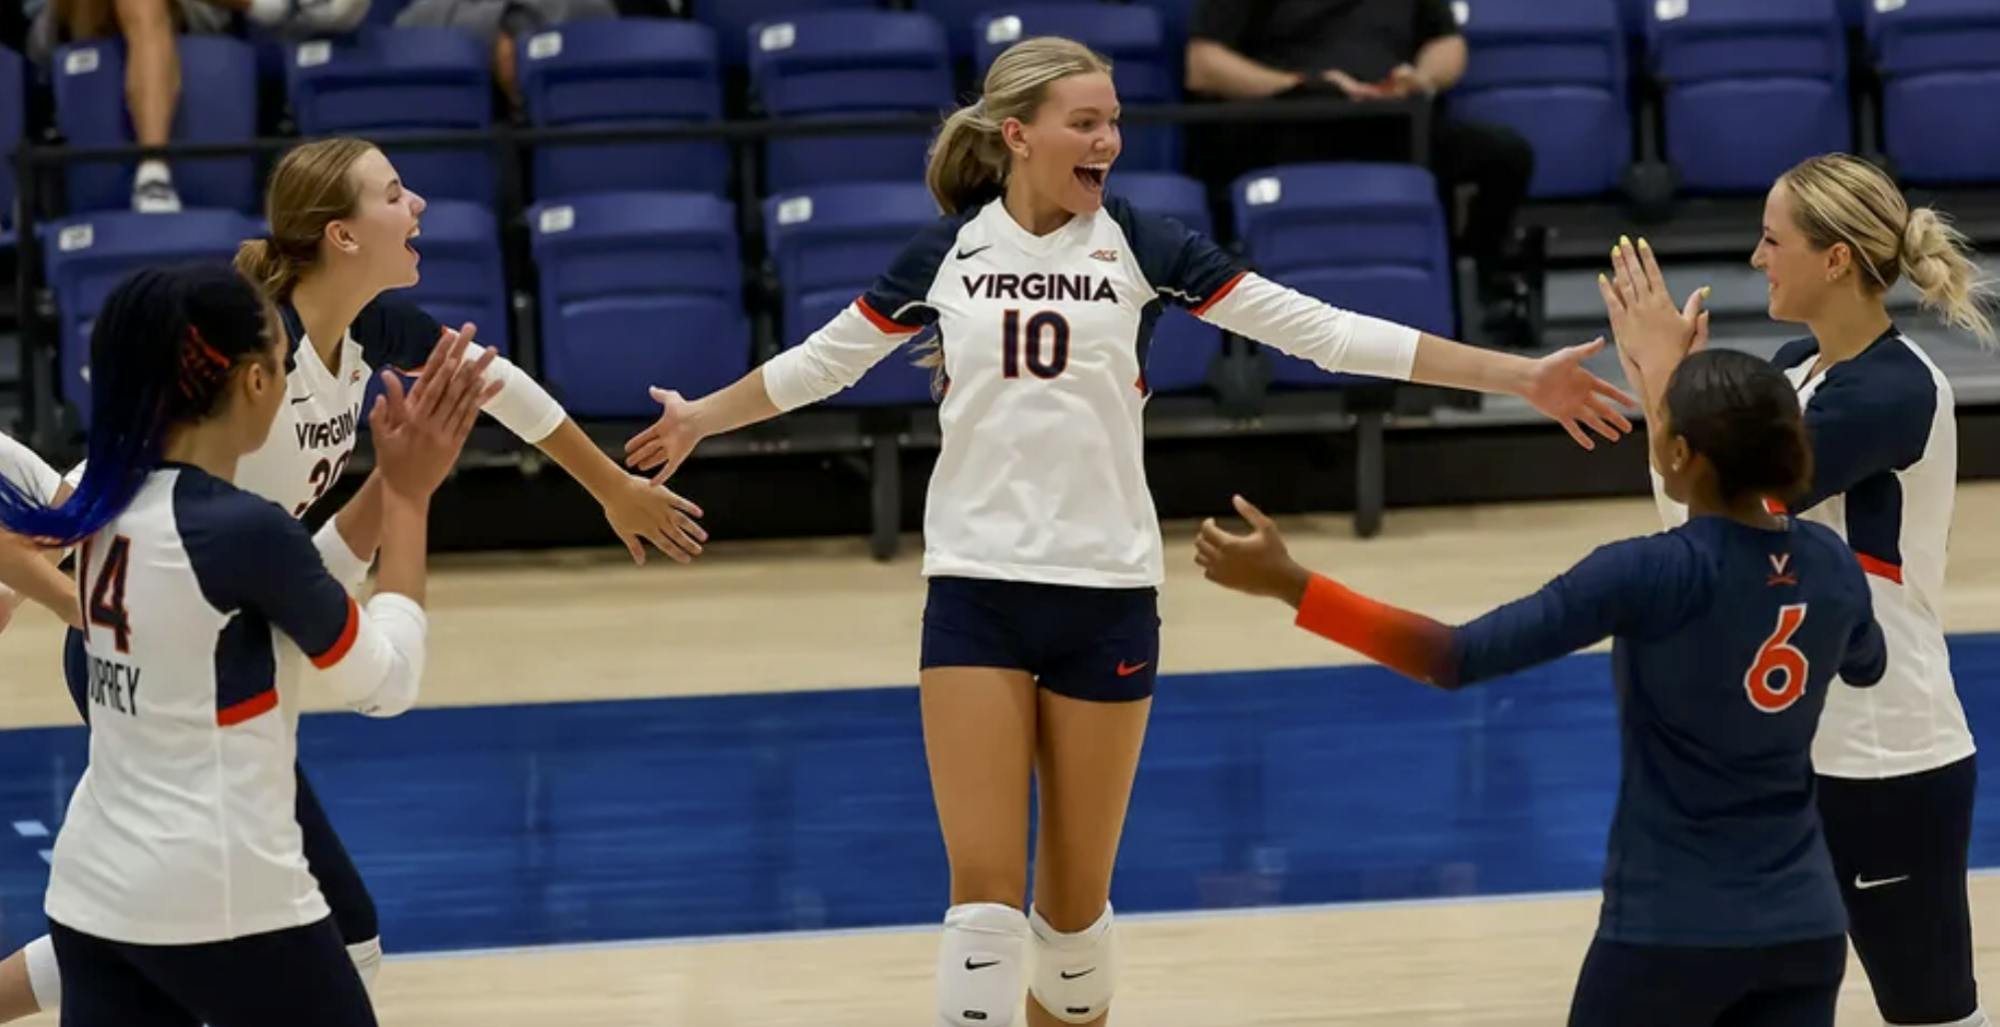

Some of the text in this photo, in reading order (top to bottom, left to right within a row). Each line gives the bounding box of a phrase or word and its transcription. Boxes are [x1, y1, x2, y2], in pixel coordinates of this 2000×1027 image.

[962, 273, 1118, 304] VIRGINIA
[1003, 309, 1070, 379] 10
[1744, 602, 1809, 713] 6
